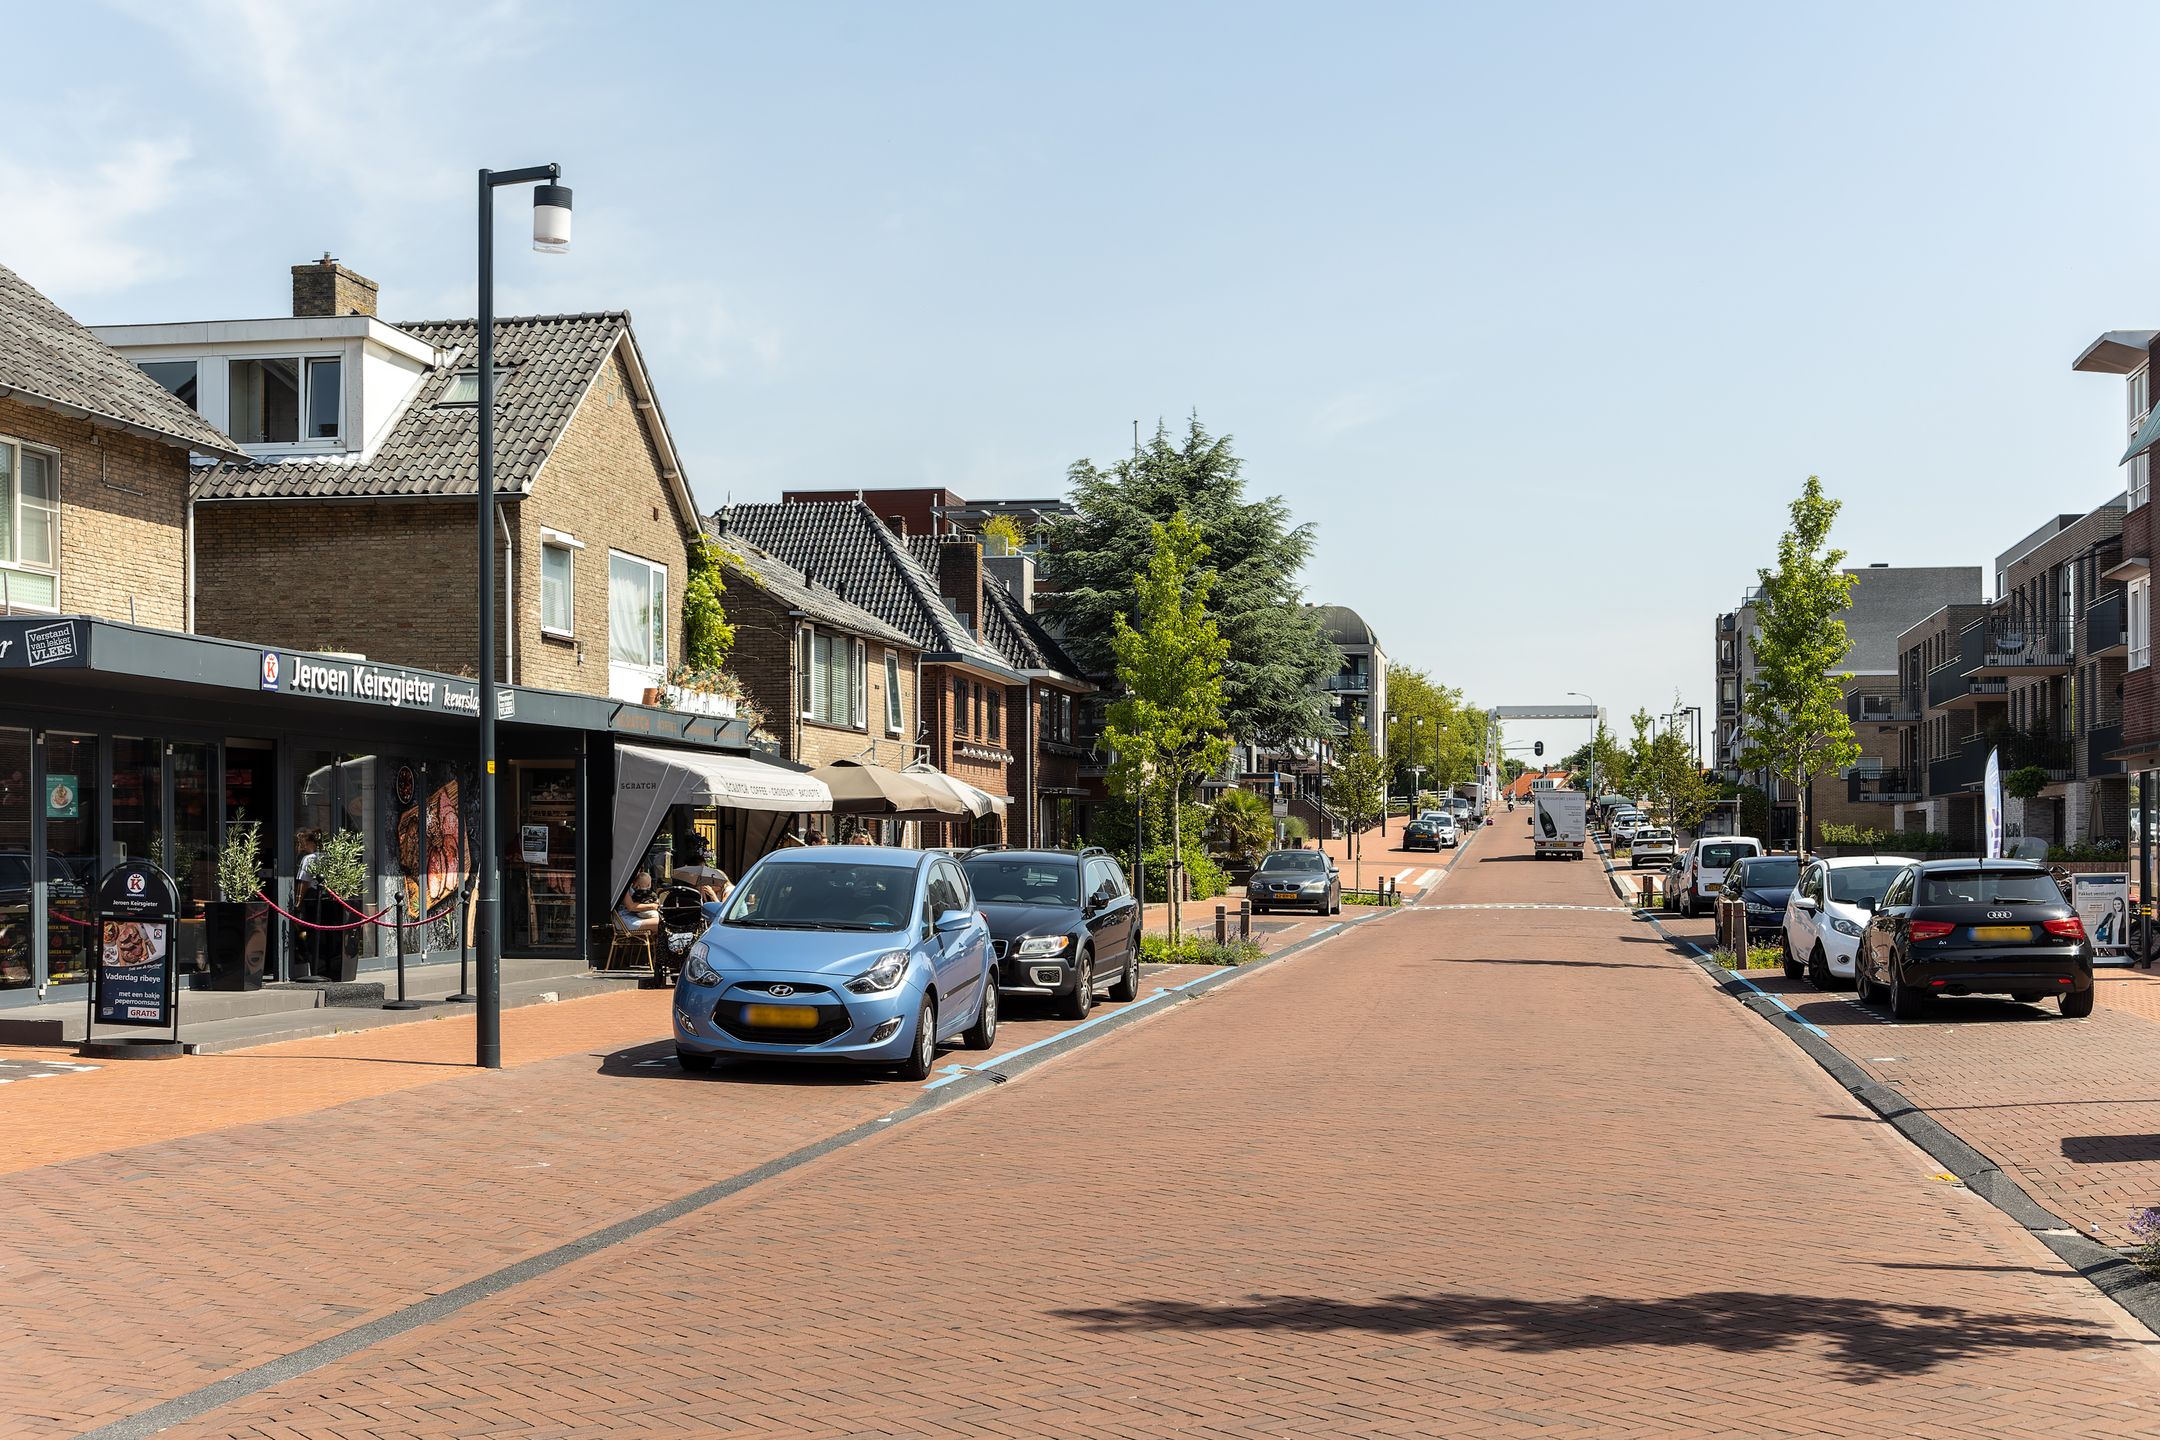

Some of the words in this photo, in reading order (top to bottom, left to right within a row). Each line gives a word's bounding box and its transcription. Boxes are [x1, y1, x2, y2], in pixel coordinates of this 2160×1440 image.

[29, 627, 71, 643] Verstand
[30, 642, 46, 651] van
[46, 636, 71, 648] lekker
[31, 643, 73, 661] VLEES
[266, 661, 276, 679] K
[291, 657, 348, 692] Jeroen
[352, 665, 436, 707] Keirsgieter
[443, 684, 480, 718] keursla
[620, 782, 657, 790] SCRATCH
[130, 878, 142, 890] K
[130, 900, 158, 908] Keirsgieter
[105, 972, 139, 983] Vaderdag
[139, 974, 161, 984] ribeye
[114, 998, 161, 1007] peperroomsaus
[144, 992, 161, 1001] bakje
[130, 1009, 157, 1018] GRATIS
